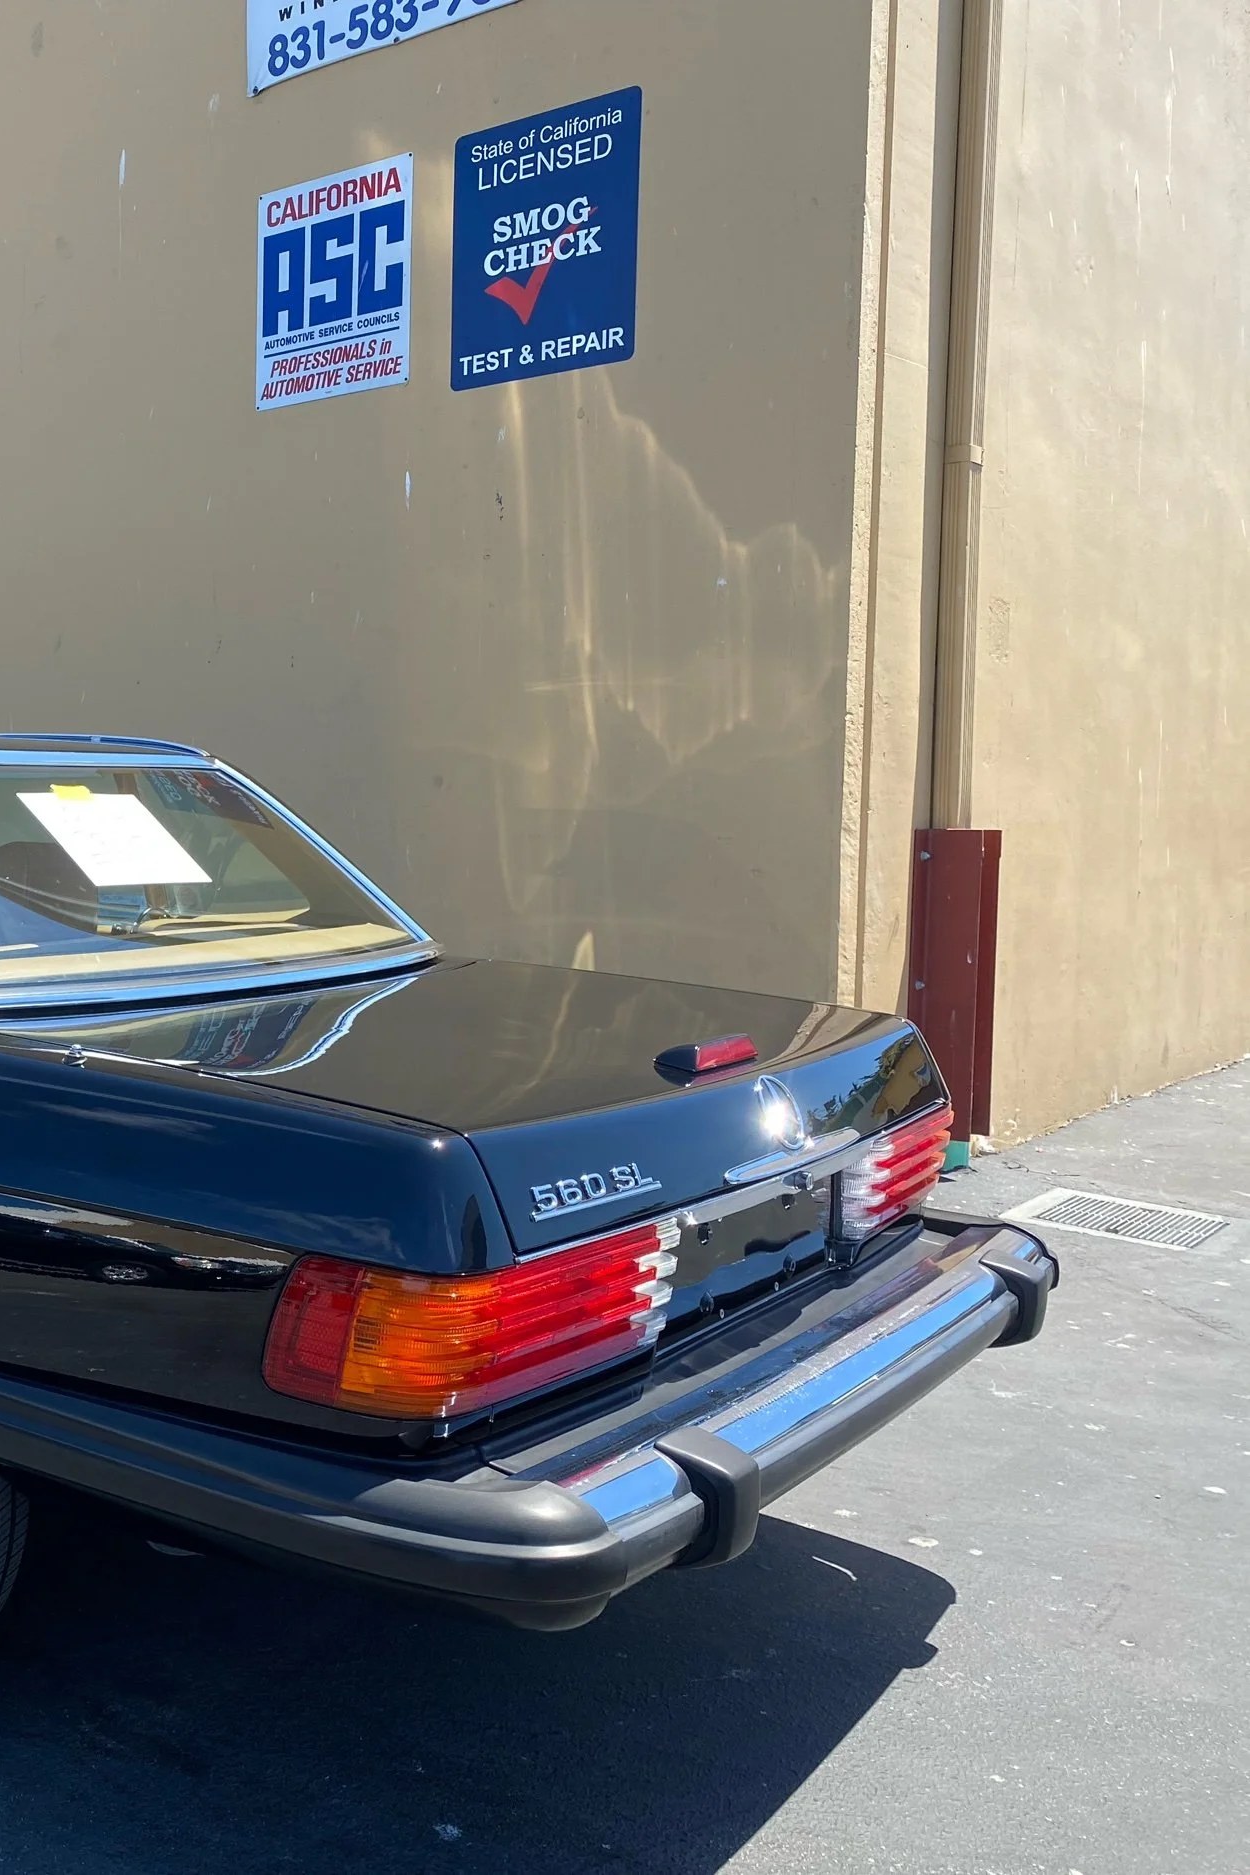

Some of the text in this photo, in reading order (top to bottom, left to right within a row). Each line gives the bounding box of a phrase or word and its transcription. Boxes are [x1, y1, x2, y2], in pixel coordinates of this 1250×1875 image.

[268, 0, 490, 76] 831-583-
[471, 108, 623, 163] State of California
[478, 133, 613, 191] LICENSED
[266, 167, 402, 228] CALIFORNIA
[493, 196, 591, 244] SMOG
[262, 200, 405, 338] ASC
[483, 226, 602, 276] CHECK
[264, 312, 400, 351] AUTOMOTIVE SERVICE COUNCILS
[459, 327, 625, 376] TEST & REPAIR
[261, 355, 403, 401] AUTOMOTIVE SERVICE
[270, 338, 392, 378] PROFESSIONALS in
[530, 1162, 653, 1212] 560 SL
